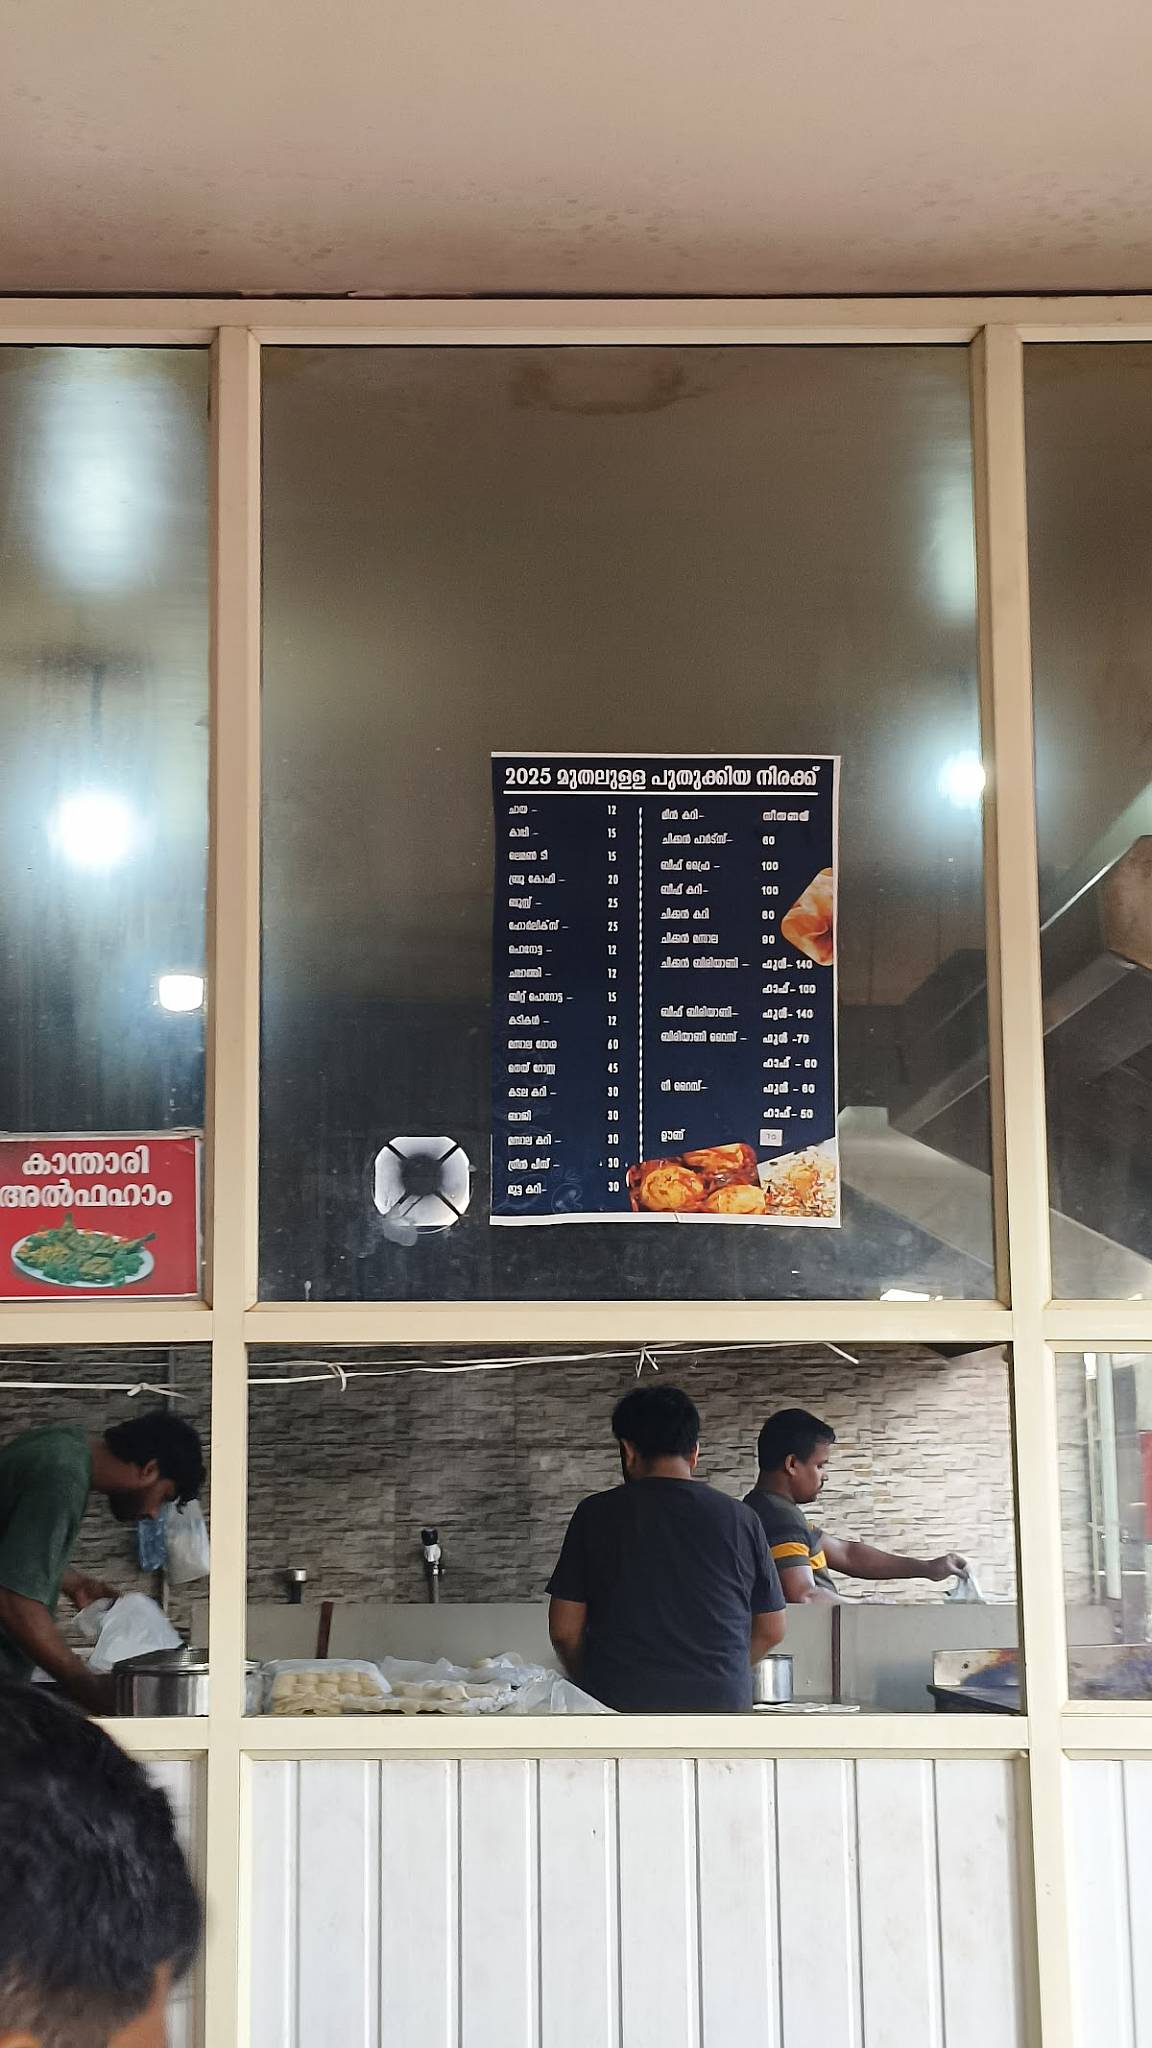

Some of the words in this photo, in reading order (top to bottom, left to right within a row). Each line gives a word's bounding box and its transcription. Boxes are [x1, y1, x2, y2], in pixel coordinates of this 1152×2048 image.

[506, 768, 551, 785] 2025
[557, 769, 646, 790] മുതലുള്ള
[652, 767, 751, 790] പുതുക്കിയ
[757, 765, 821, 786] നിരക്ക്
[608, 805, 616, 815] 12
[608, 828, 616, 838] 15
[608, 851, 616, 861] 15
[762, 861, 779, 871] 100
[608, 874, 618, 884] 20
[762, 886, 779, 896] 100
[608, 898, 618, 908] 25
[608, 921, 618, 931] 25
[608, 945, 617, 955] 12
[796, 959, 813, 969] 140
[608, 968, 617, 978] 12
[799, 985, 816, 994] 100
[608, 992, 617, 1002] 15
[796, 1009, 814, 1019] 140
[608, 1016, 617, 1026] 12
[608, 1039, 618, 1049] 60
[608, 1063, 618, 1073] 45
[608, 1087, 618, 1097] 30
[608, 1110, 618, 1120] 30
[800, 1109, 814, 1119] 50
[608, 1134, 619, 1144] 30
[22, 1145, 150, 1175] കാന്താരി
[608, 1158, 619, 1168] 30
[608, 1182, 619, 1192] 30
